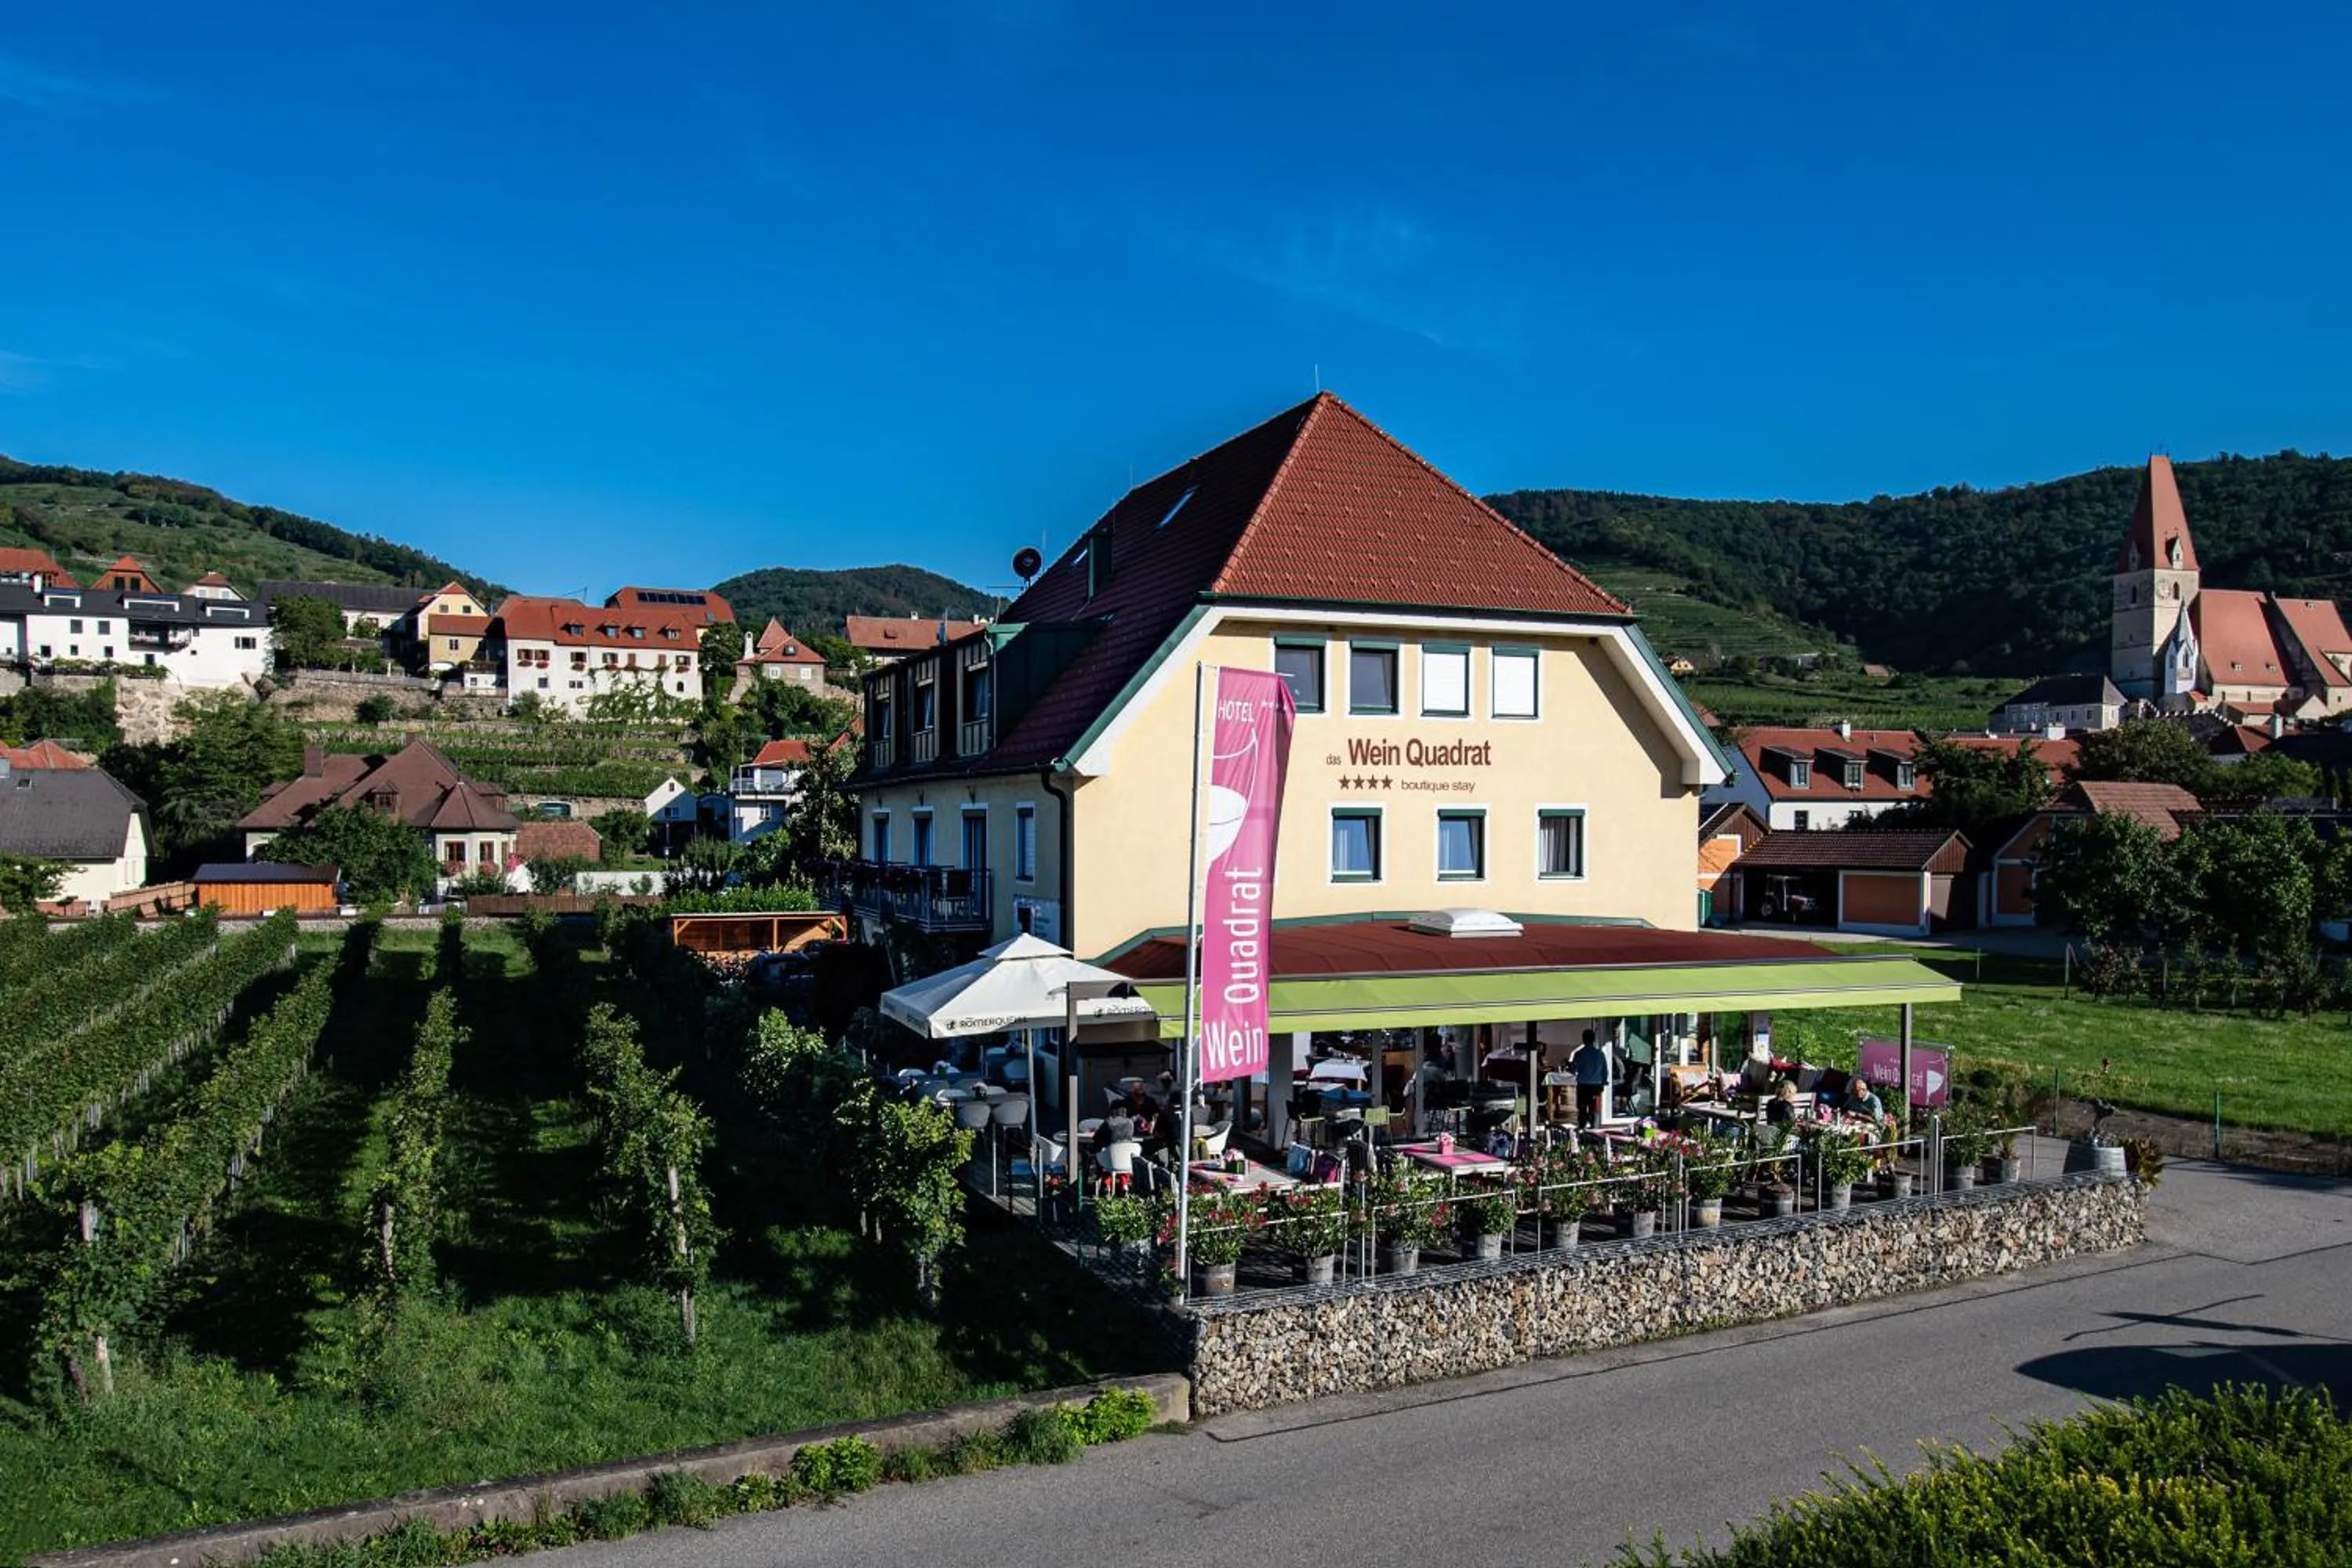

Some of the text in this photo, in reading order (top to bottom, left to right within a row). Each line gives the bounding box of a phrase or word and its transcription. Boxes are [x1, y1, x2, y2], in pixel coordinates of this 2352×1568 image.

[1218, 700, 1254, 721] HOTEL
[1326, 738, 1491, 767] das Wein Quadrat
[1401, 779, 1475, 793] boutique stay
[1223, 866, 1264, 1004] Quadrat
[1204, 1022, 1263, 1071] Wein
